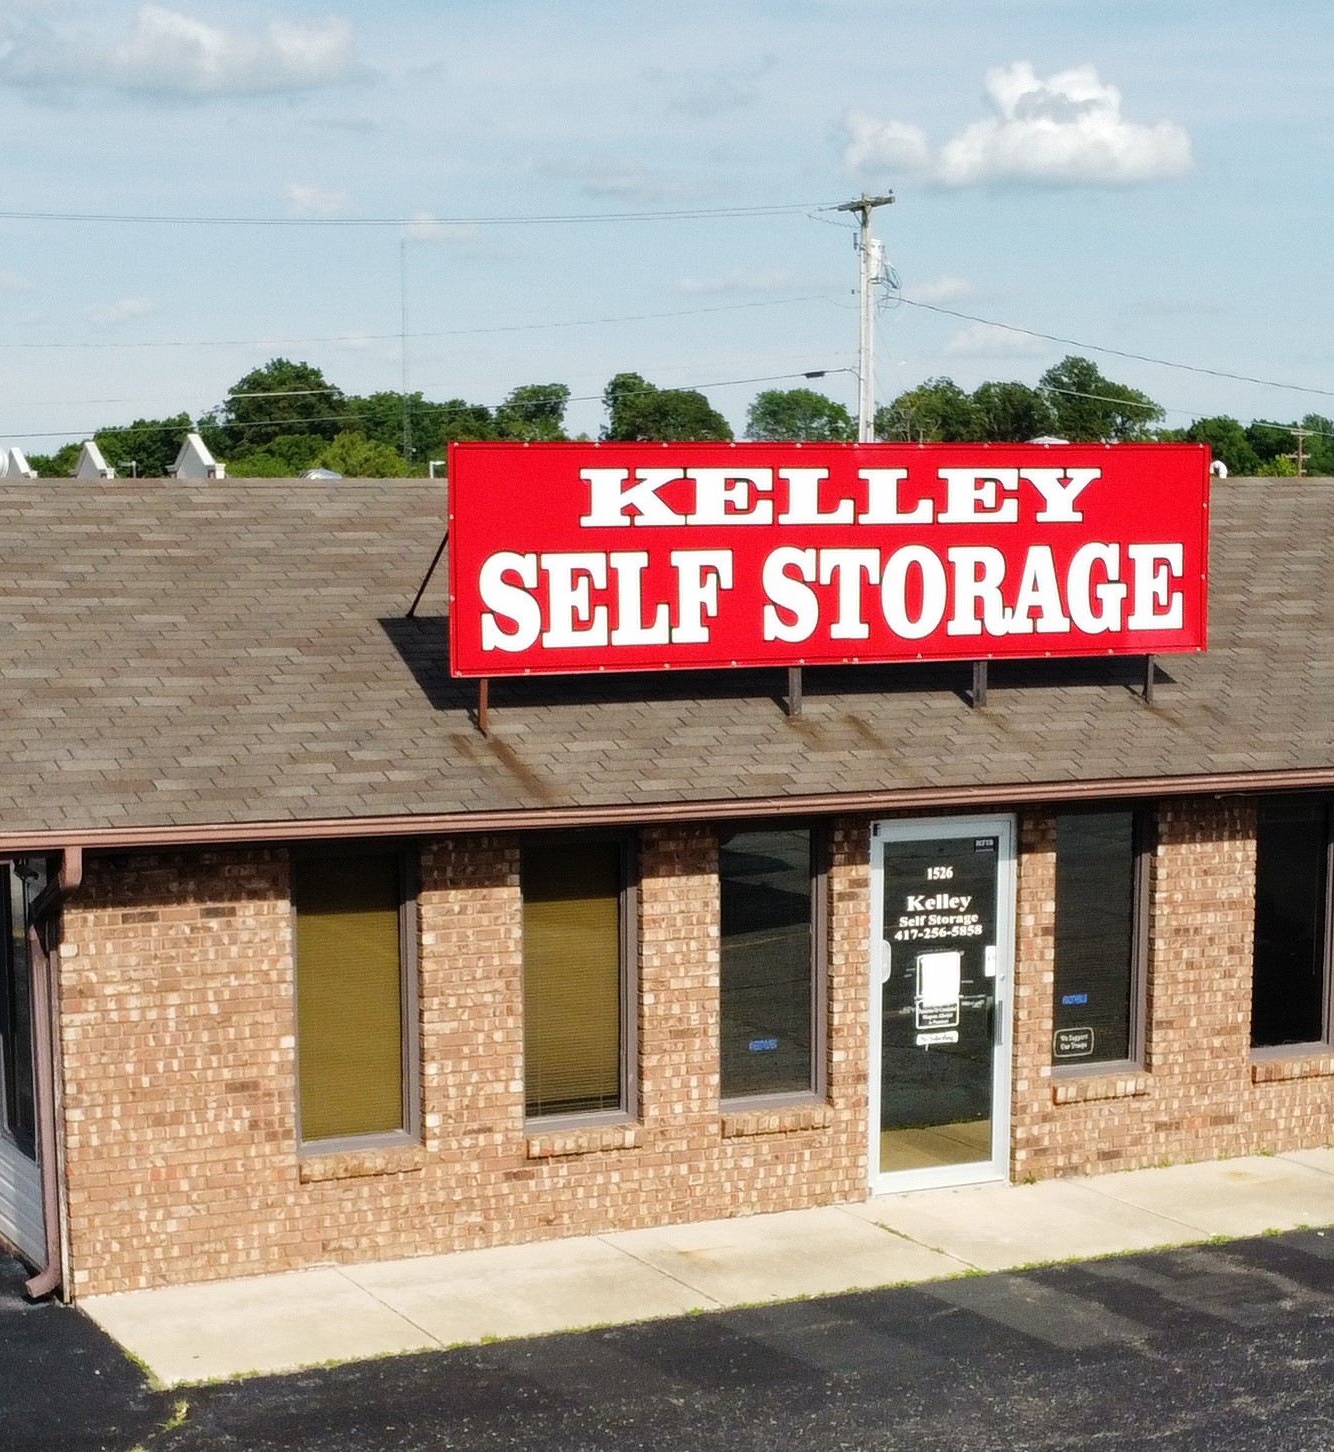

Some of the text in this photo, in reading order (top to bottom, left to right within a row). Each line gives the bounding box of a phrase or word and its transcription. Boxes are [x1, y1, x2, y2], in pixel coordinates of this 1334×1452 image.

[579, 466, 1101, 528] KELLEY
[479, 541, 1184, 653] SELF STORAGE
[927, 866, 954, 880] 1526
[906, 894, 972, 912] Kelley
[899, 914, 979, 928] Self Storage
[894, 924, 983, 941] 417-256-5858
